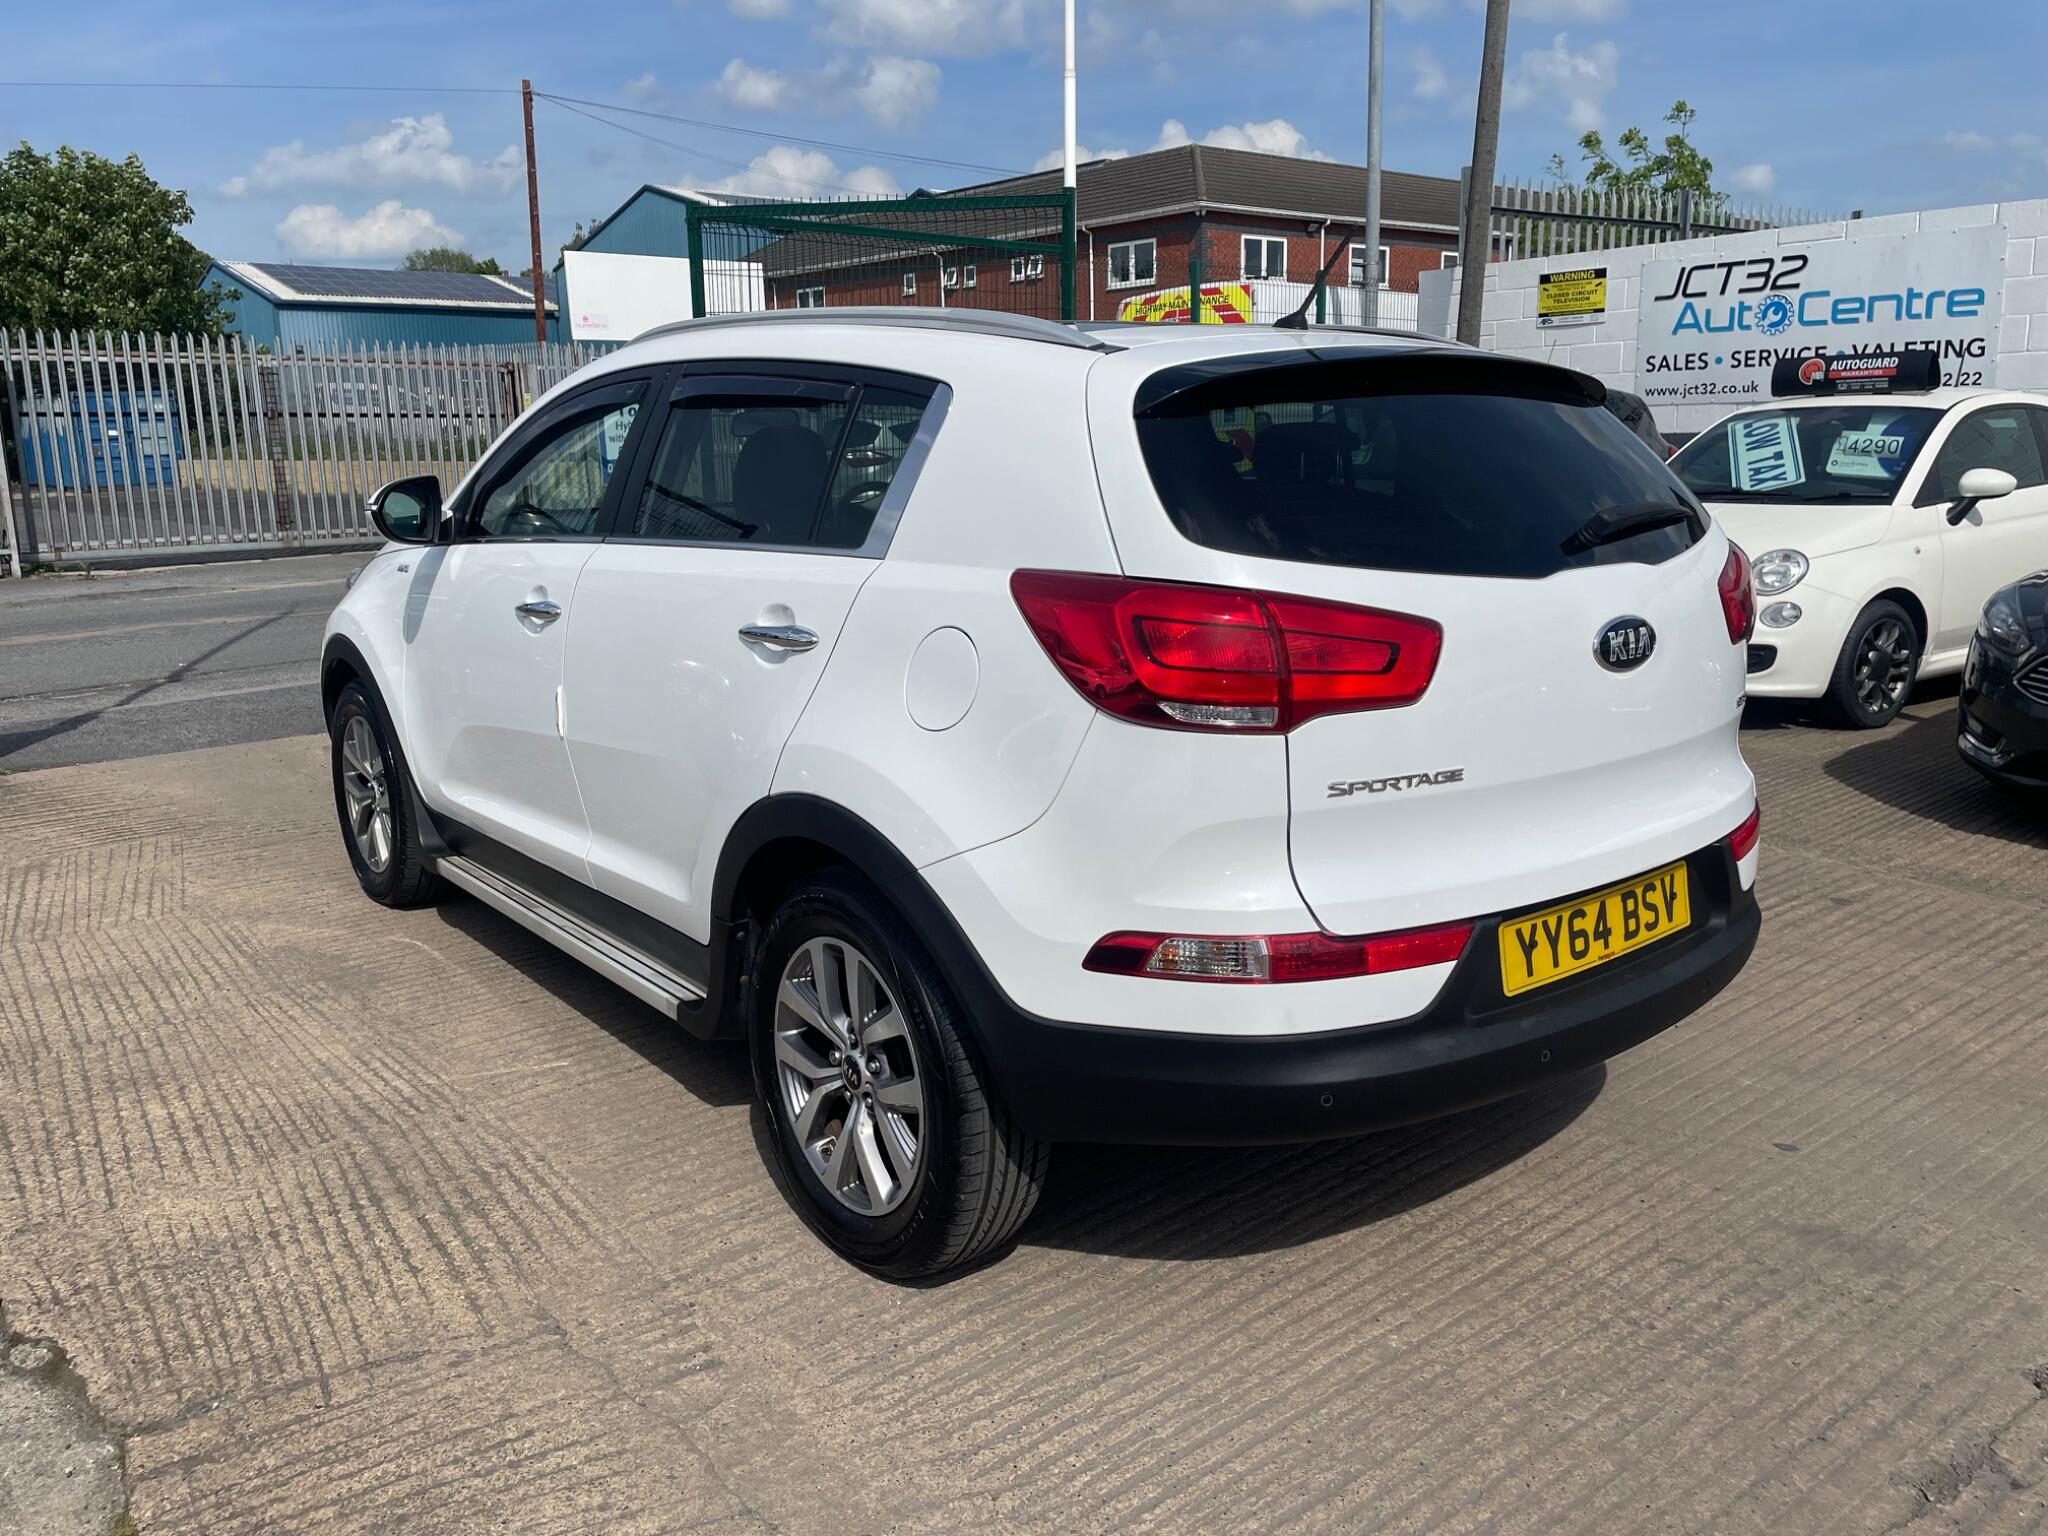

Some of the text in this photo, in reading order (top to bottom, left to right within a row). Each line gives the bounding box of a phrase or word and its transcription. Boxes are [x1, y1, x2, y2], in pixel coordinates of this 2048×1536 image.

[1550, 270, 1595, 282] WARNING
[1654, 254, 1808, 301] JCT32
[1135, 294, 1230, 315] HIGHWAY MAINNANCE
[1546, 289, 1598, 299] CLOSED CIRCUIT
[1553, 296, 1590, 304] TELEVISION
[1645, 352, 1709, 373] SALES
[1829, 357, 1899, 371] AUTOGUARD
[1840, 369, 1883, 377] WARRANTIES
[1645, 381, 1759, 398] www.jct32.co.uk
[1747, 450, 1788, 489] TAX
[1608, 627, 1651, 662] KIA
[1327, 768, 1464, 798] SPORTAGE
[1516, 872, 1678, 978] YY64 BSV
